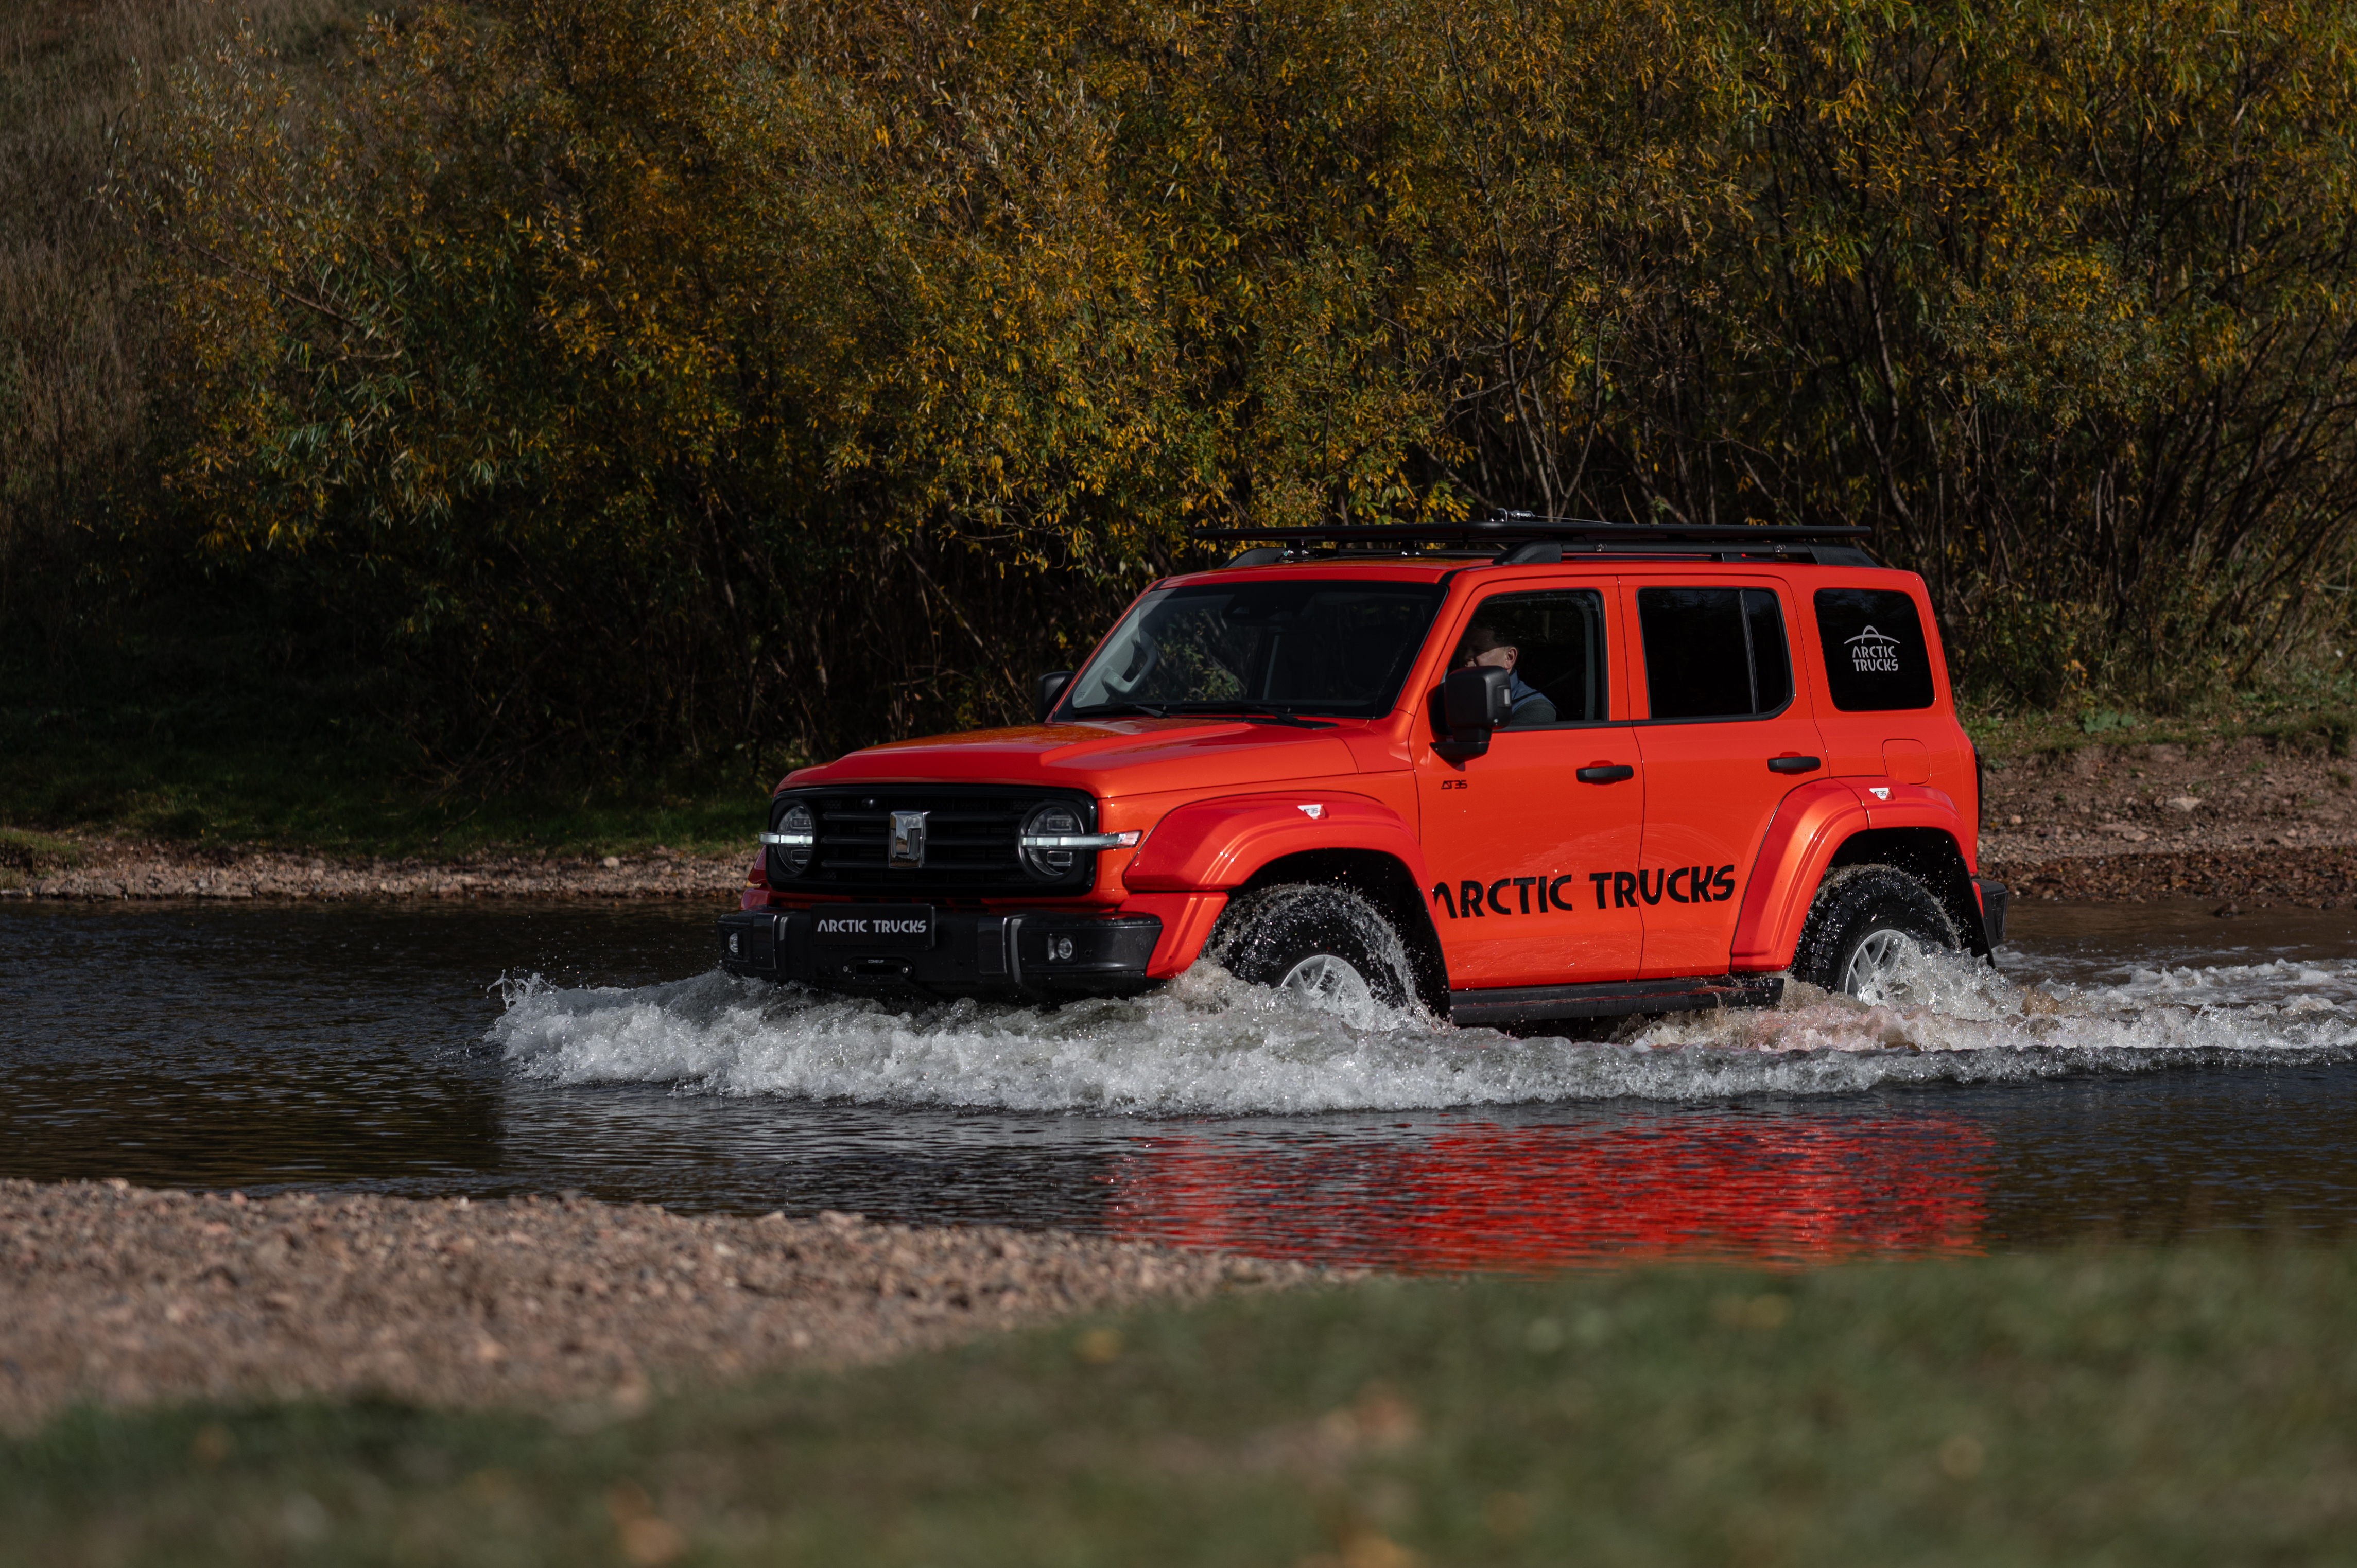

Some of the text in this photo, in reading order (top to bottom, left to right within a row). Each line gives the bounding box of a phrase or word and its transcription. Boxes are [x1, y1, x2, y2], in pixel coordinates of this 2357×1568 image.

[1852, 646, 1896, 658] ARCTIC
[1852, 659, 1899, 672] TRUCKS
[1441, 780, 1467, 789] AT35
[1433, 864, 1735, 919] ARCTIC TRUCKS
[817, 919, 926, 933] ARCTIC TRUCKS
